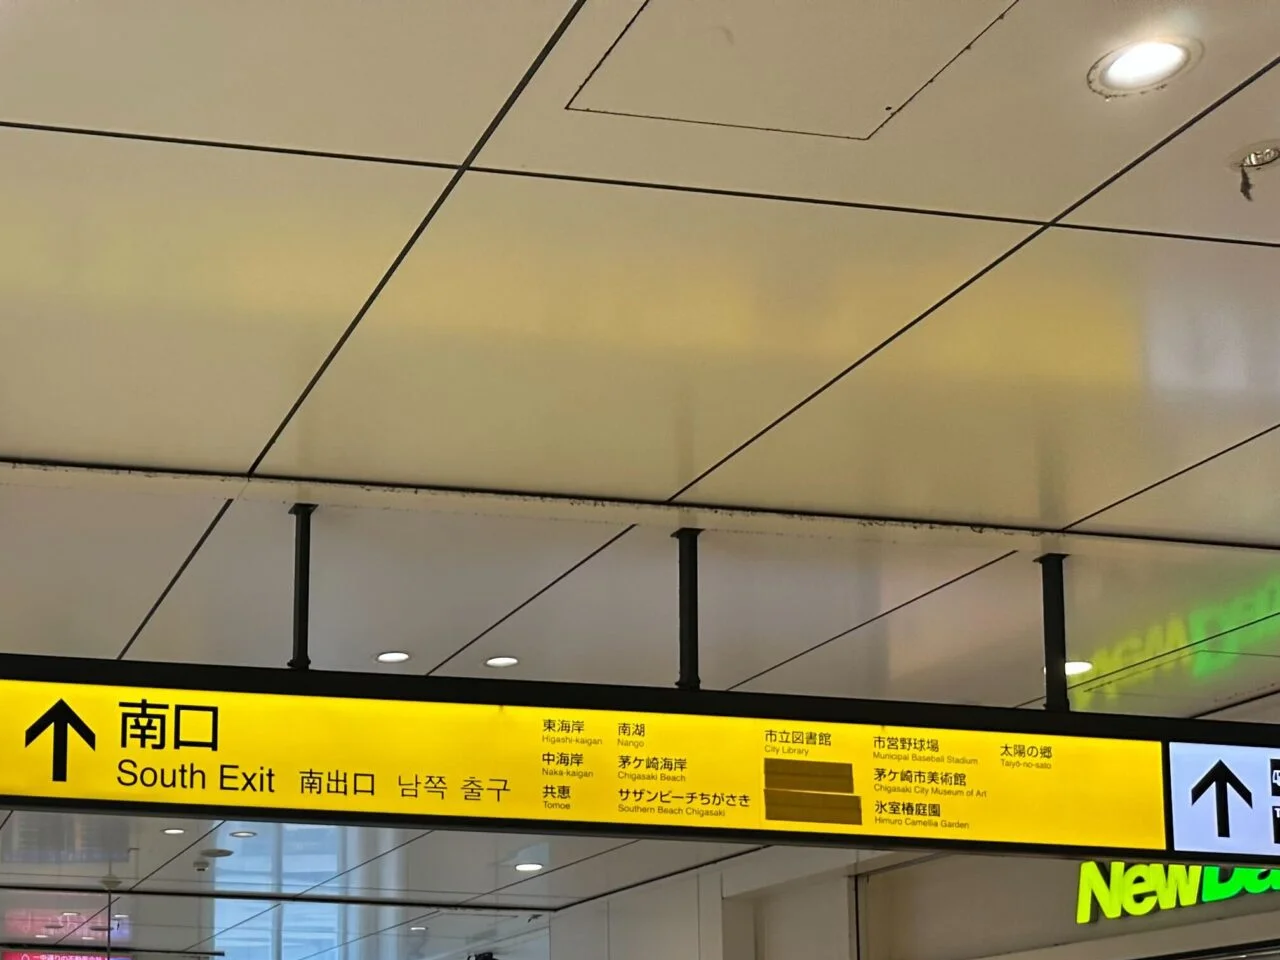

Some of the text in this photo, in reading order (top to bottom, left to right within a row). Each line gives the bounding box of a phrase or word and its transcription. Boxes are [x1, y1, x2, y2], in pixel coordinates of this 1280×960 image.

[119, 699, 218, 751] 南口
[543, 718, 584, 734] 東海岸
[618, 722, 645, 737] 南湖
[542, 735, 602, 746] Higashi-kaigan
[618, 738, 644, 748] Nango
[765, 729, 831, 746] 市立図書館
[874, 736, 939, 752] 市営野球場
[765, 745, 809, 756] City Library
[873, 751, 978, 765] Municipal Baseball Stadium
[1000, 744, 1052, 759] 太陽の郷
[542, 752, 583, 767] 中海岸
[117, 759, 275, 792] South Exit
[542, 767, 593, 778] Naka-kaigan
[618, 771, 686, 782] Chigasaki Beach
[299, 769, 374, 795] 南出口
[398, 774, 511, 802] 남쪽 출구
[543, 784, 570, 799] 共恵
[619, 788, 750, 807] サザンビーチちがさき
[874, 783, 987, 797] Chigasaki City Museum of Art
[544, 800, 570, 810] Tomoe
[618, 804, 725, 817] Southern Beach Chigasaki
[875, 800, 941, 817] 氷室椿庭園
[875, 816, 969, 829] Himuro Camellia Garden
